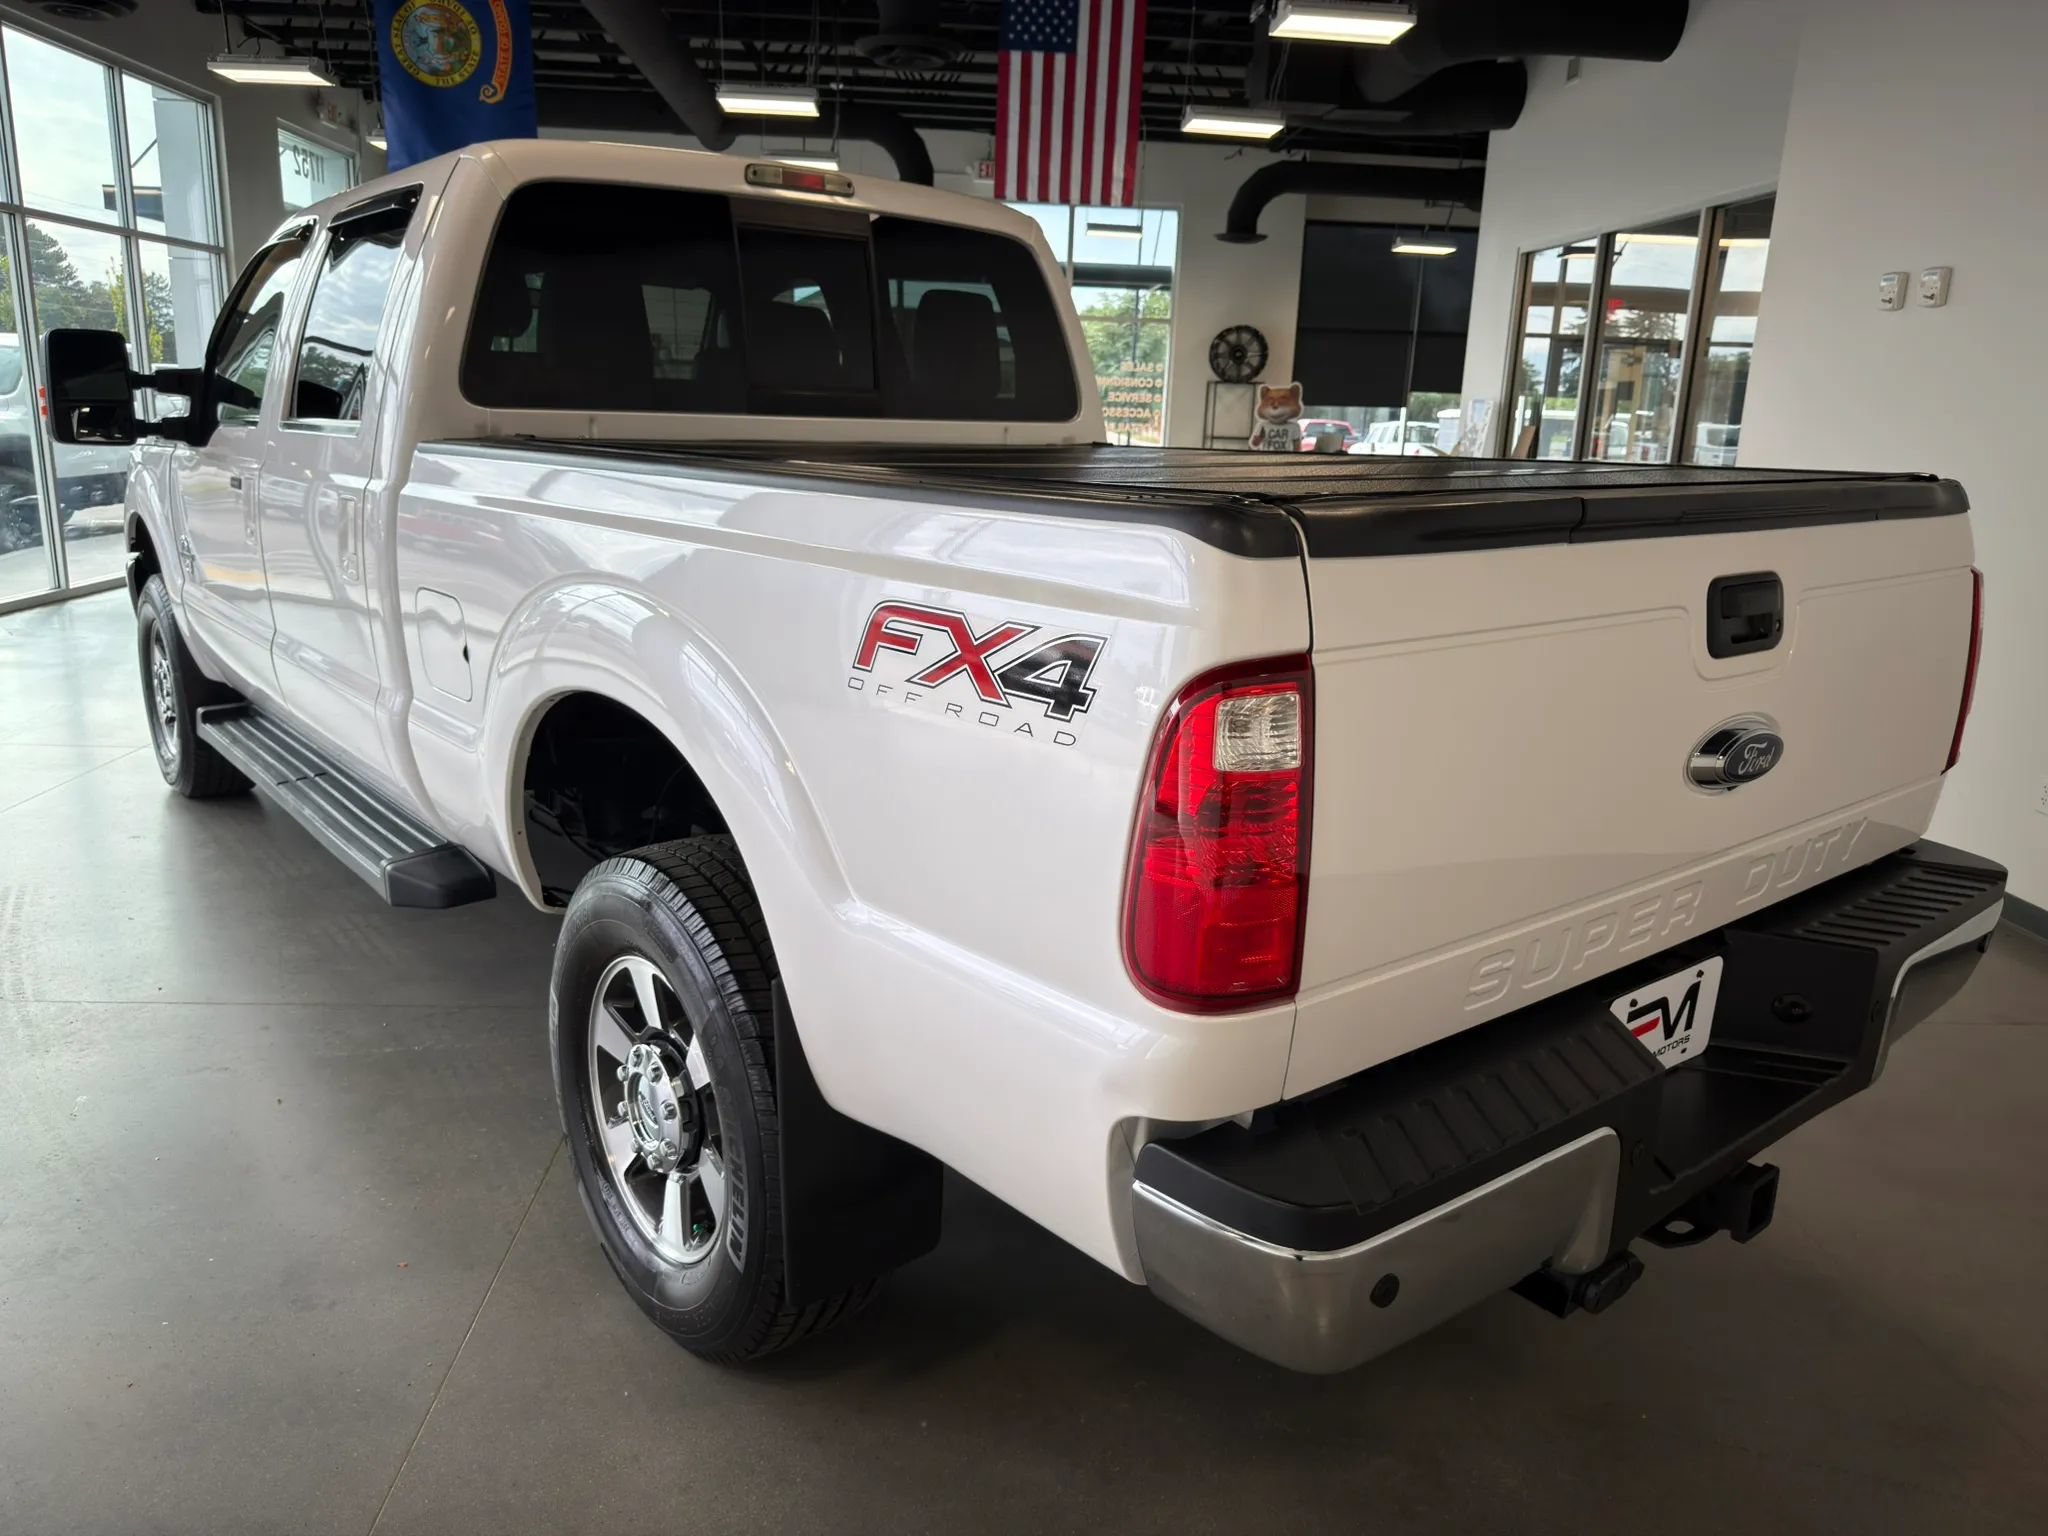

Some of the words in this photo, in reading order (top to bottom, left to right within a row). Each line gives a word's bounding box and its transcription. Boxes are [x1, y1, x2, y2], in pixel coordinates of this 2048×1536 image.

[1267, 428, 1289, 440] CAR
[1267, 440, 1287, 450] FOX
[852, 599, 1111, 723] FX4
[1737, 740, 1776, 776] Ford
[1463, 880, 1705, 1012] SUPER
[1735, 816, 1870, 907] DUTY
[1652, 1034, 1691, 1057] MOTORS
